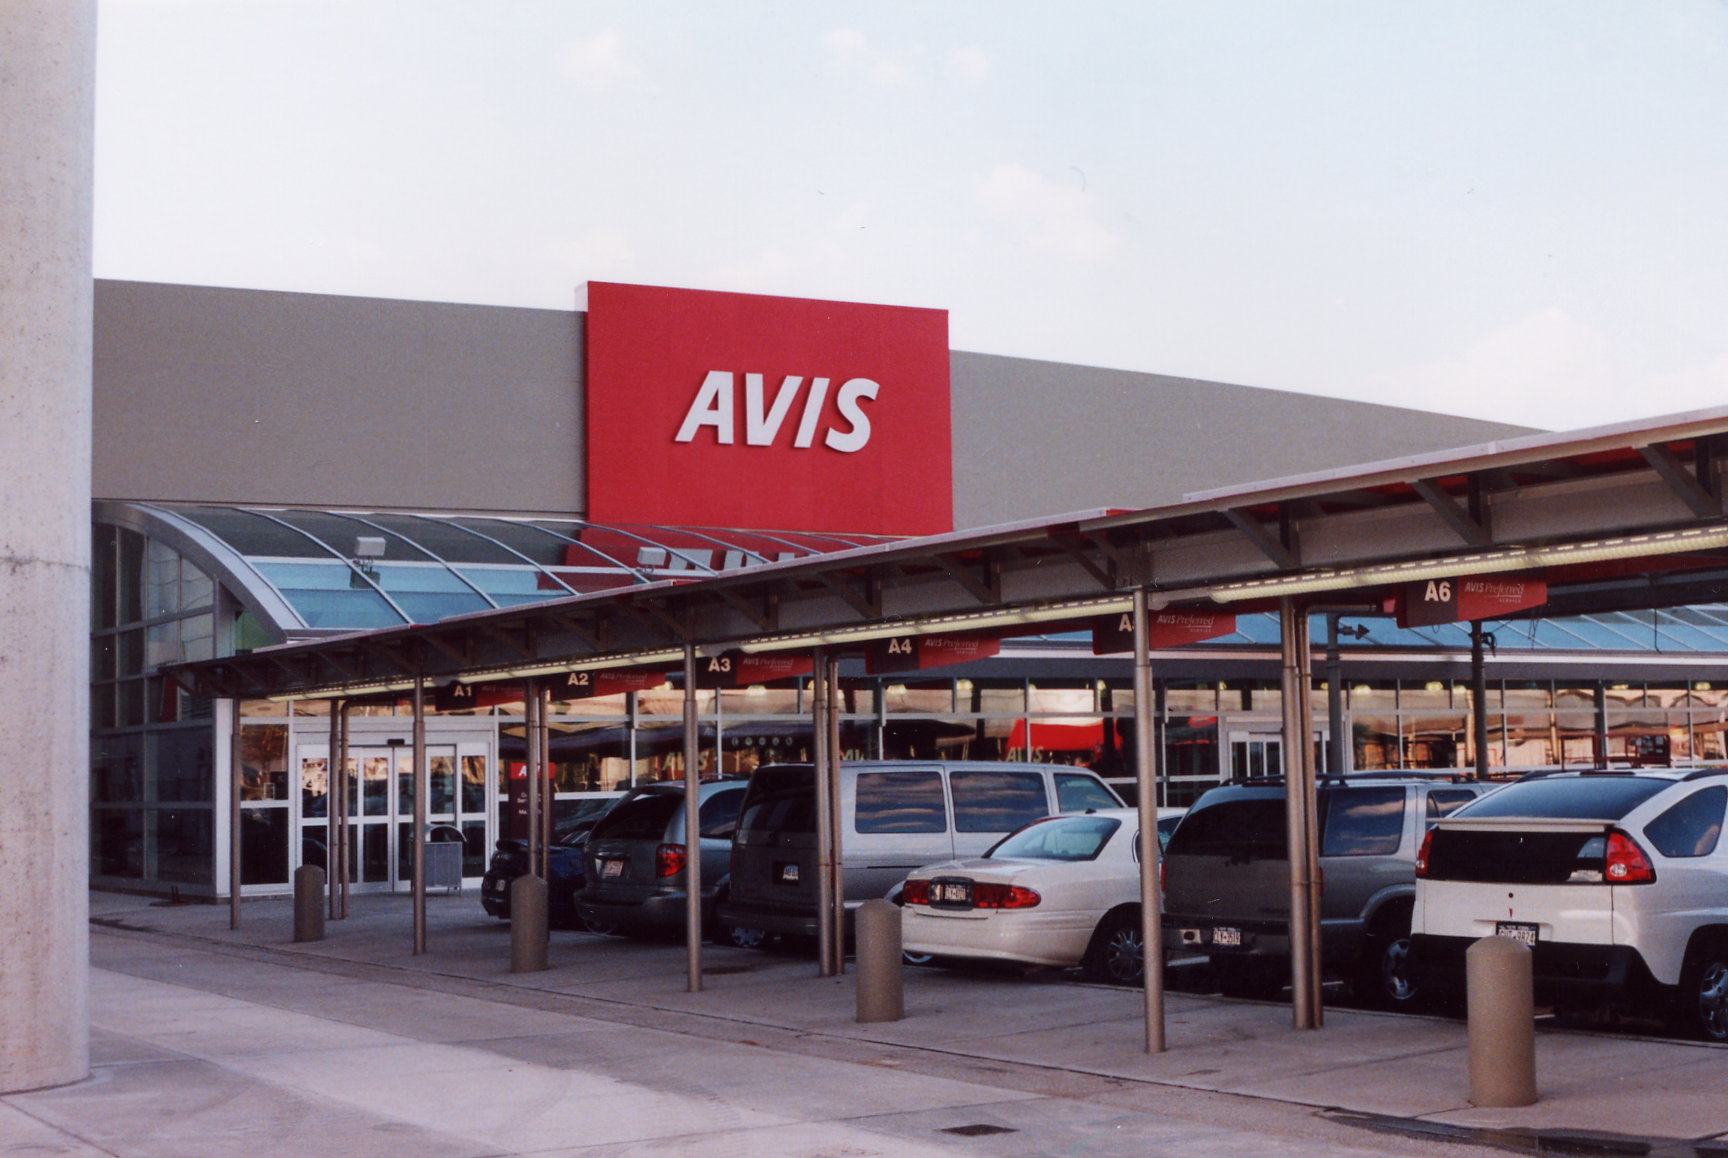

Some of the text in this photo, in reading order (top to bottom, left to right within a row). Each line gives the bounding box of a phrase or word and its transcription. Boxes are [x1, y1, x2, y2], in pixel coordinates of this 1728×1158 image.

[674, 370, 880, 453] AVIS
[1424, 581, 1451, 602] A6
[1464, 582, 1524, 598] AVIS Preferred
[1118, 613, 1134, 632] A
[1156, 614, 1215, 628] AVIS Preferred
[888, 638, 912, 655] A4
[924, 638, 942, 648] AVIS
[708, 657, 731, 672] A3
[567, 672, 589, 686] A2
[454, 684, 472, 697] A1
